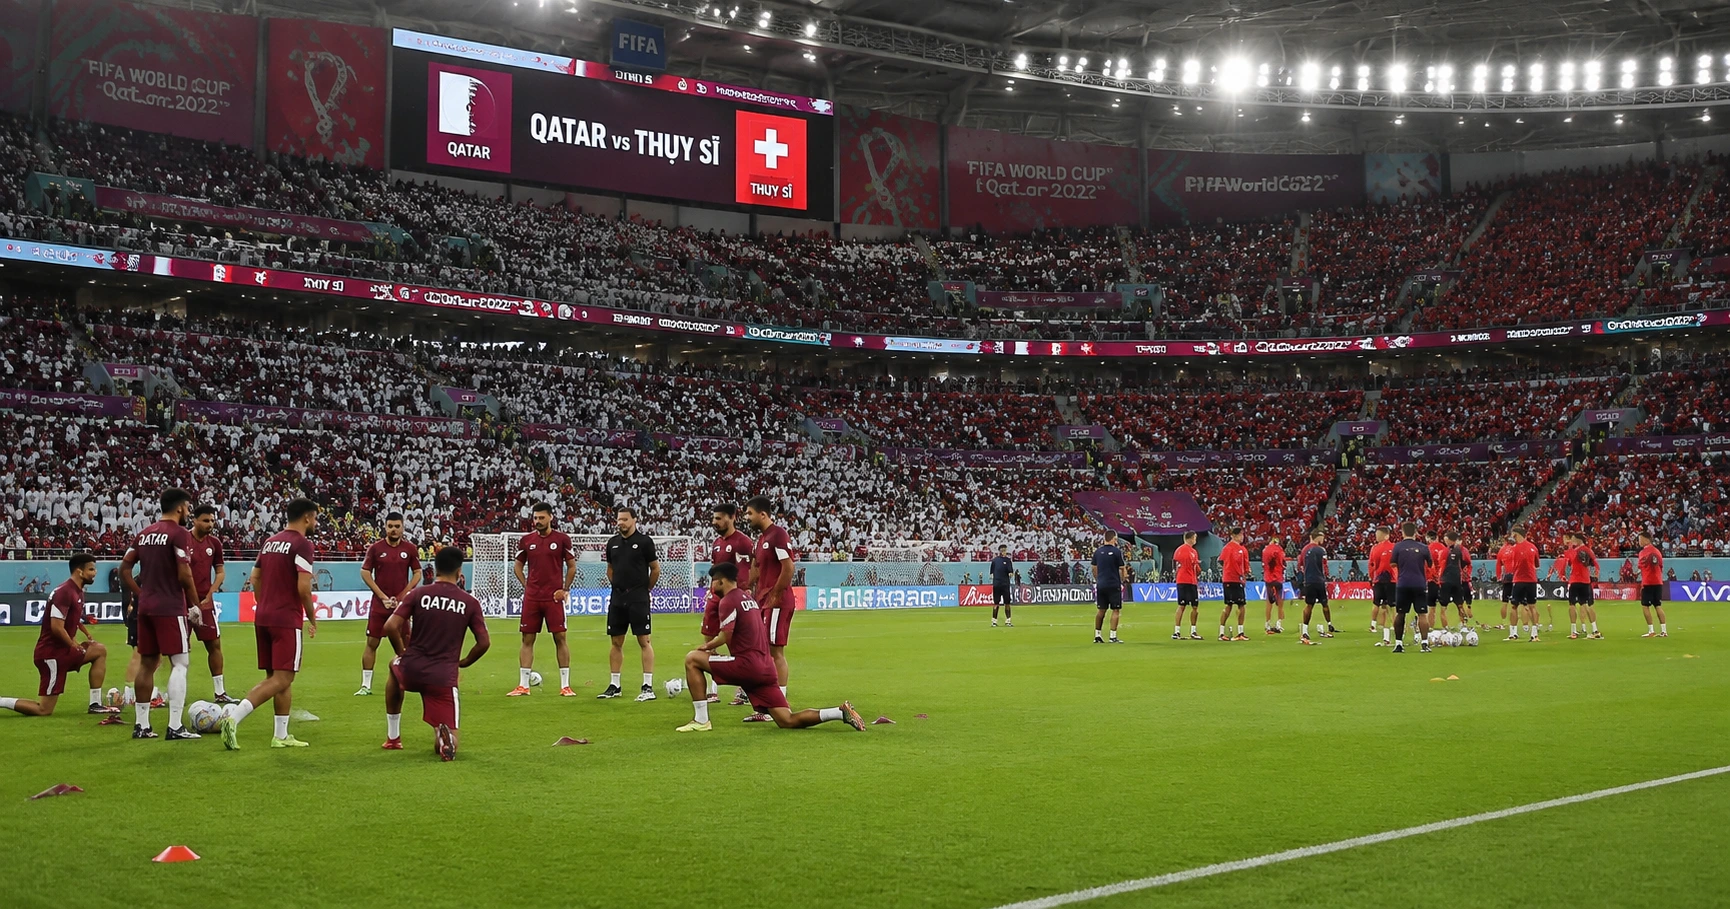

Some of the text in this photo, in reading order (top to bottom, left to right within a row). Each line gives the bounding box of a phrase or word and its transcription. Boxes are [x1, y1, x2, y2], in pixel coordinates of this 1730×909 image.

[619, 32, 658, 55] FIFA
[88, 60, 126, 82] FIFA
[530, 112, 607, 149] QATAR
[611, 134, 631, 151] vs
[634, 129, 695, 165] THỤY
[447, 141, 491, 160] QATAR
[967, 161, 1006, 177] FIFA
[1009, 164, 1067, 181] WORLD
[1050, 183, 1097, 200] 2022
[421, 594, 467, 615] QATAR
